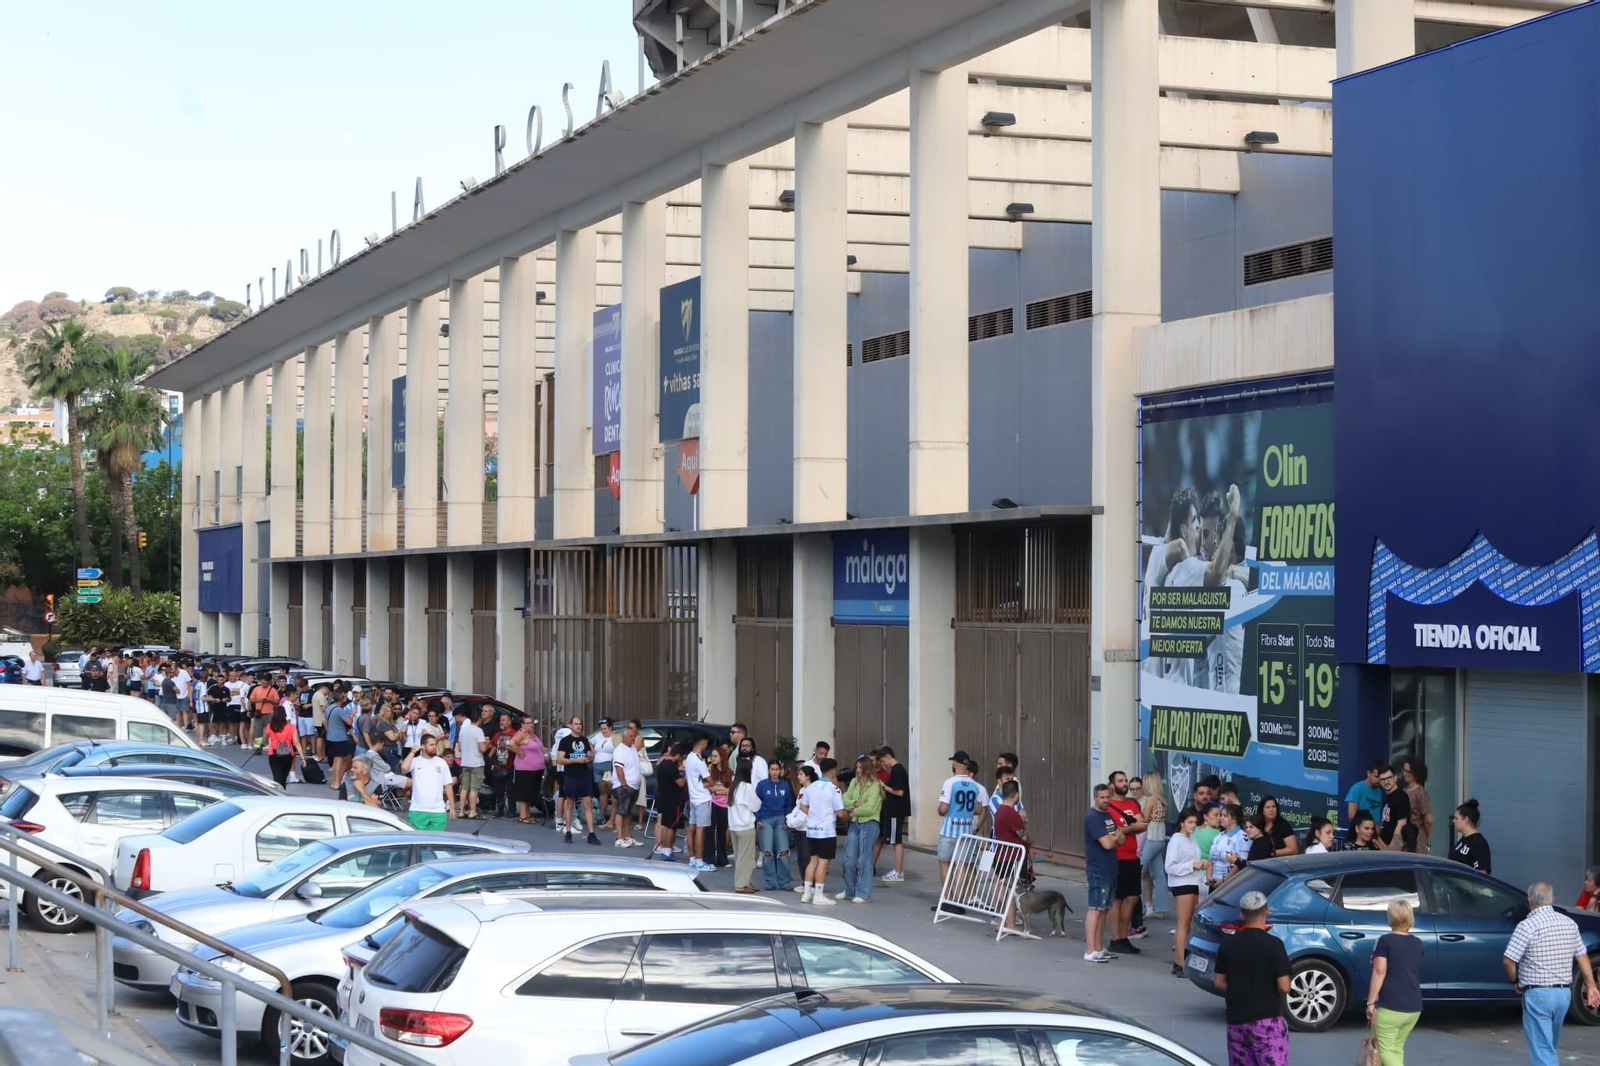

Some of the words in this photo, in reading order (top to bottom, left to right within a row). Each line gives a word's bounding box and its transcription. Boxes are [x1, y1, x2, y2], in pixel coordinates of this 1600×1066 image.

[1263, 443, 1307, 487] Olin
[1262, 572, 1281, 590] DEL
[1283, 566, 1330, 590] MÁLAGA
[1152, 592, 1166, 606] POR
[1168, 592, 1182, 606] SER
[1182, 592, 1230, 608] MALAGUISTA,
[1152, 616, 1160, 628] TE
[1161, 616, 1188, 630] DAMOS
[1188, 616, 1221, 630] NUESTRA
[1152, 638, 1174, 652] MEJOR
[1176, 640, 1204, 653] OFERTA
[1261, 634, 1277, 646] Fibra
[1278, 634, 1294, 646] Start
[1305, 634, 1322, 648] Todo
[1414, 624, 1472, 648] TIENDA
[1476, 625, 1540, 652] OFICIAL
[1259, 660, 1285, 705] 15
[1287, 664, 1293, 676] €
[1305, 663, 1333, 708] 19
[1168, 710, 1190, 748] POR
[1191, 711, 1242, 752] USTEDES!
[1260, 722, 1282, 735] 300Mb
[1308, 726, 1332, 739] 300Mb
[1308, 748, 1326, 762] 20GB
[956, 790, 976, 812] 98
